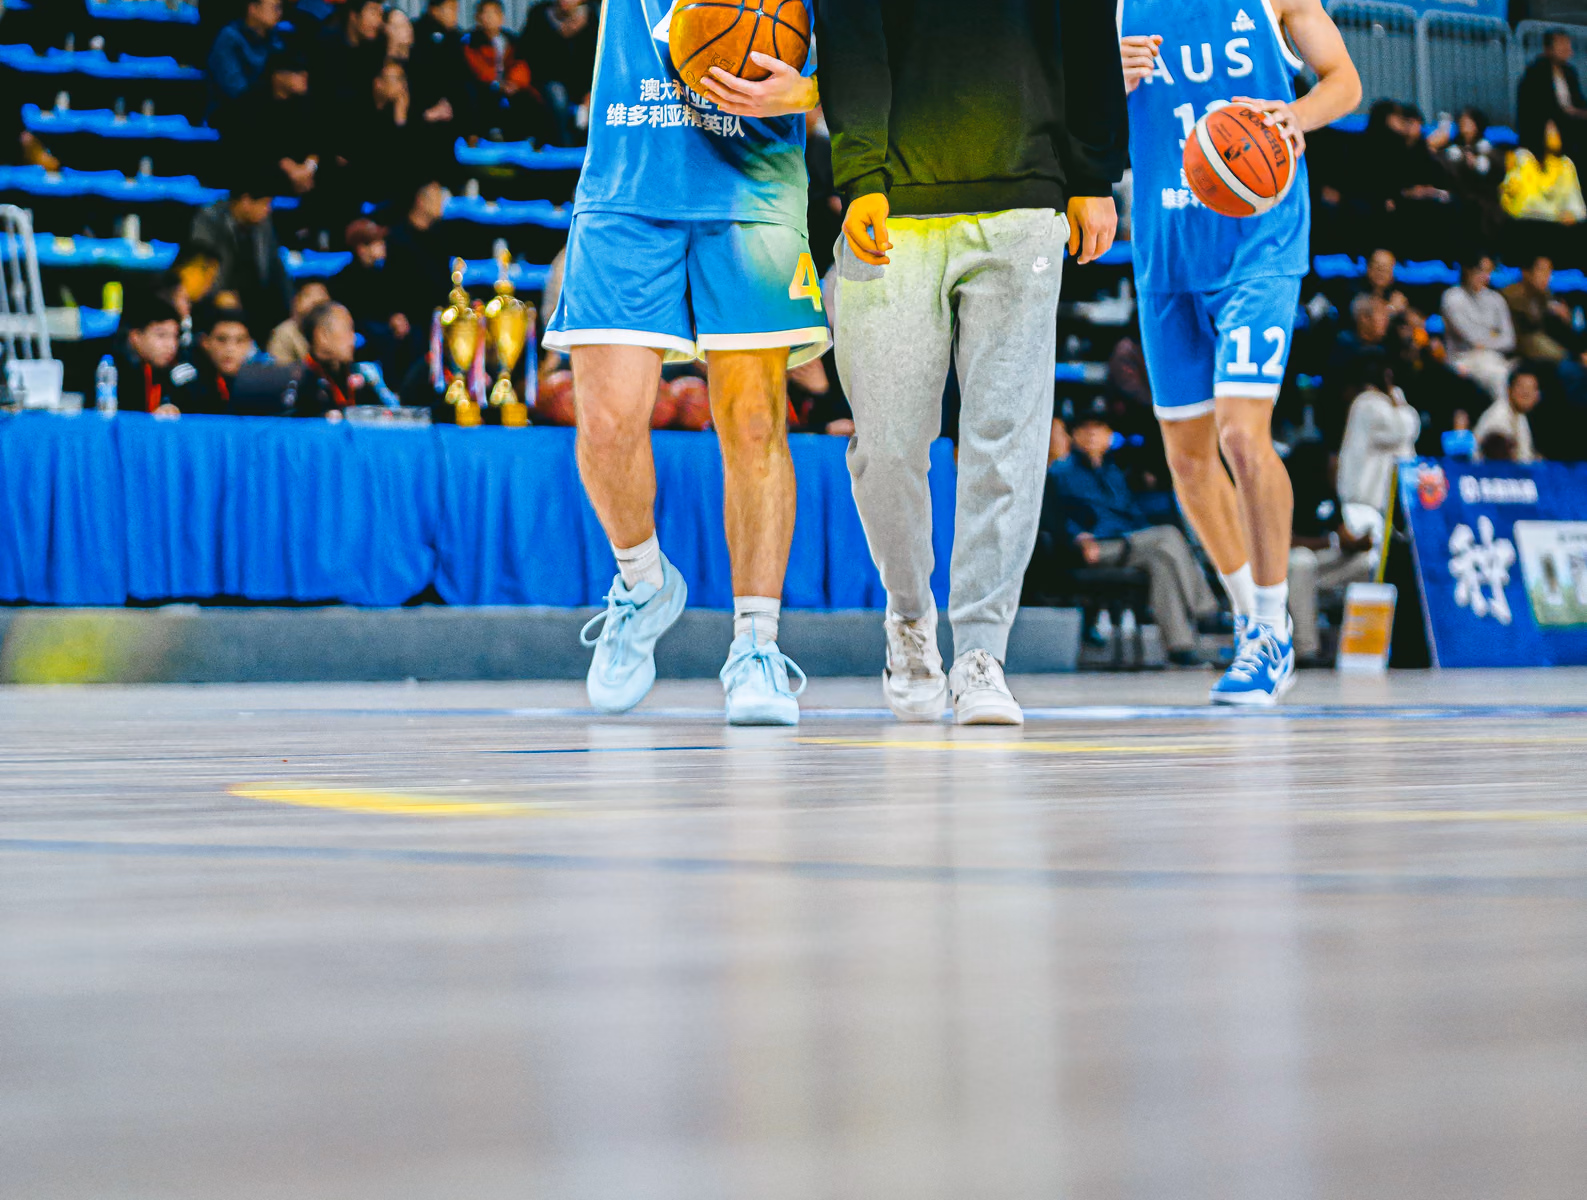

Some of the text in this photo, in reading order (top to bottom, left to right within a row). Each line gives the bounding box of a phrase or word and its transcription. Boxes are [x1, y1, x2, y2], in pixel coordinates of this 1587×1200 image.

[1143, 37, 1254, 85] AUS
[605, 102, 746, 138] 维多利亚精英队
[788, 252, 823, 313] 4
[1226, 325, 1286, 376] 12
